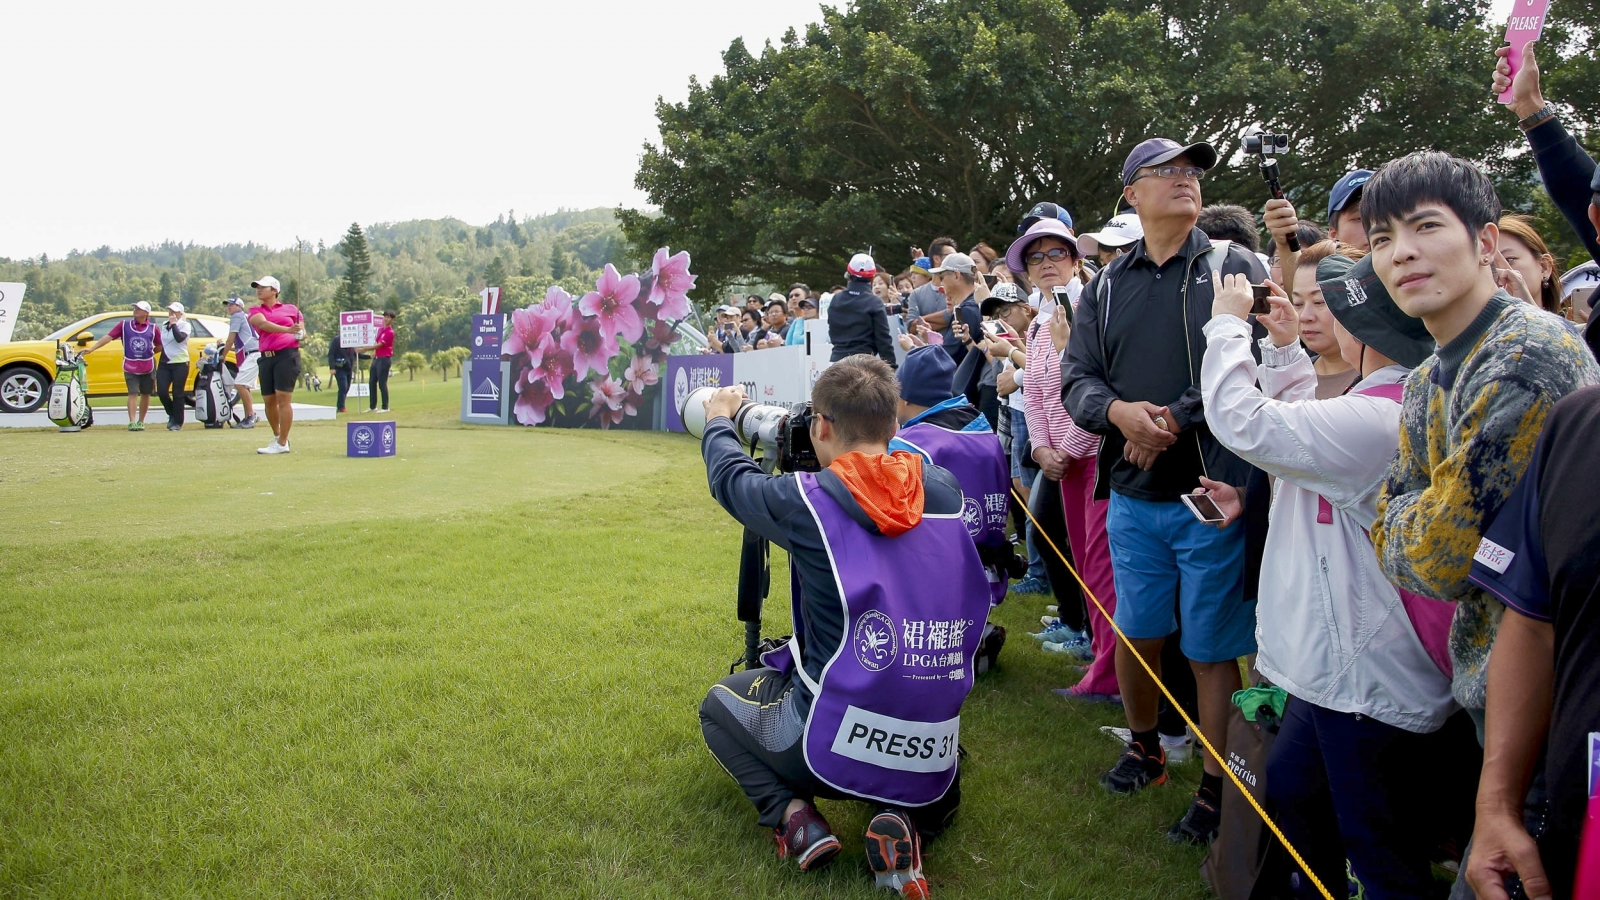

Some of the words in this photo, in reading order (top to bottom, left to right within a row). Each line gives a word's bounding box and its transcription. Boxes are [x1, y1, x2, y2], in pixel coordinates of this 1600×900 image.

[1509, 16, 1540, 31] PLEASE
[479, 286, 500, 315] 17
[764, 385, 774, 396] Audi
[861, 654, 879, 669] Taiwan
[847, 722, 936, 759] PRESS
[938, 733, 955, 759] 31
